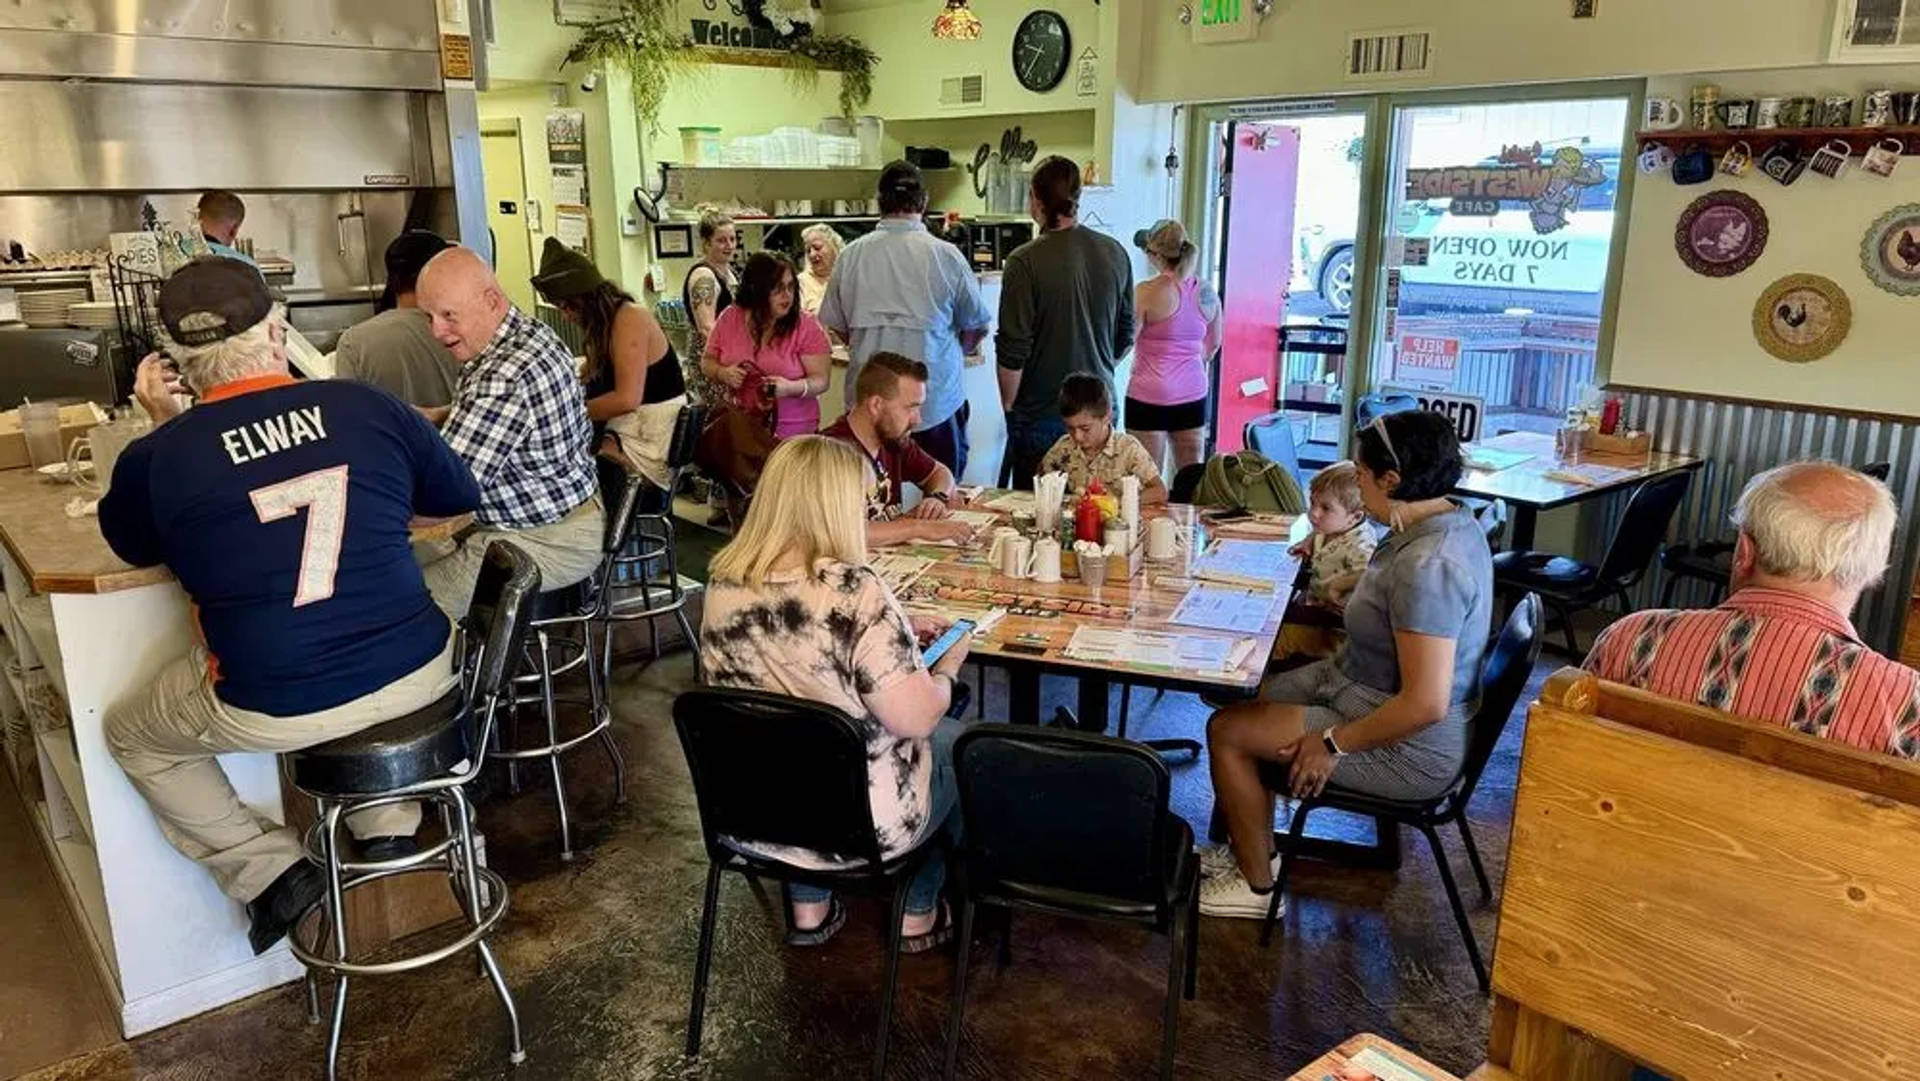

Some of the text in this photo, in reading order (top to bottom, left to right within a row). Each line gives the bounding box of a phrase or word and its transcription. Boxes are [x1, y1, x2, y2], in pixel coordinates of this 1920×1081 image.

[1202, 0, 1241, 24] EXIT
[221, 405, 328, 465] ELWAY
[248, 463, 349, 608] 7
